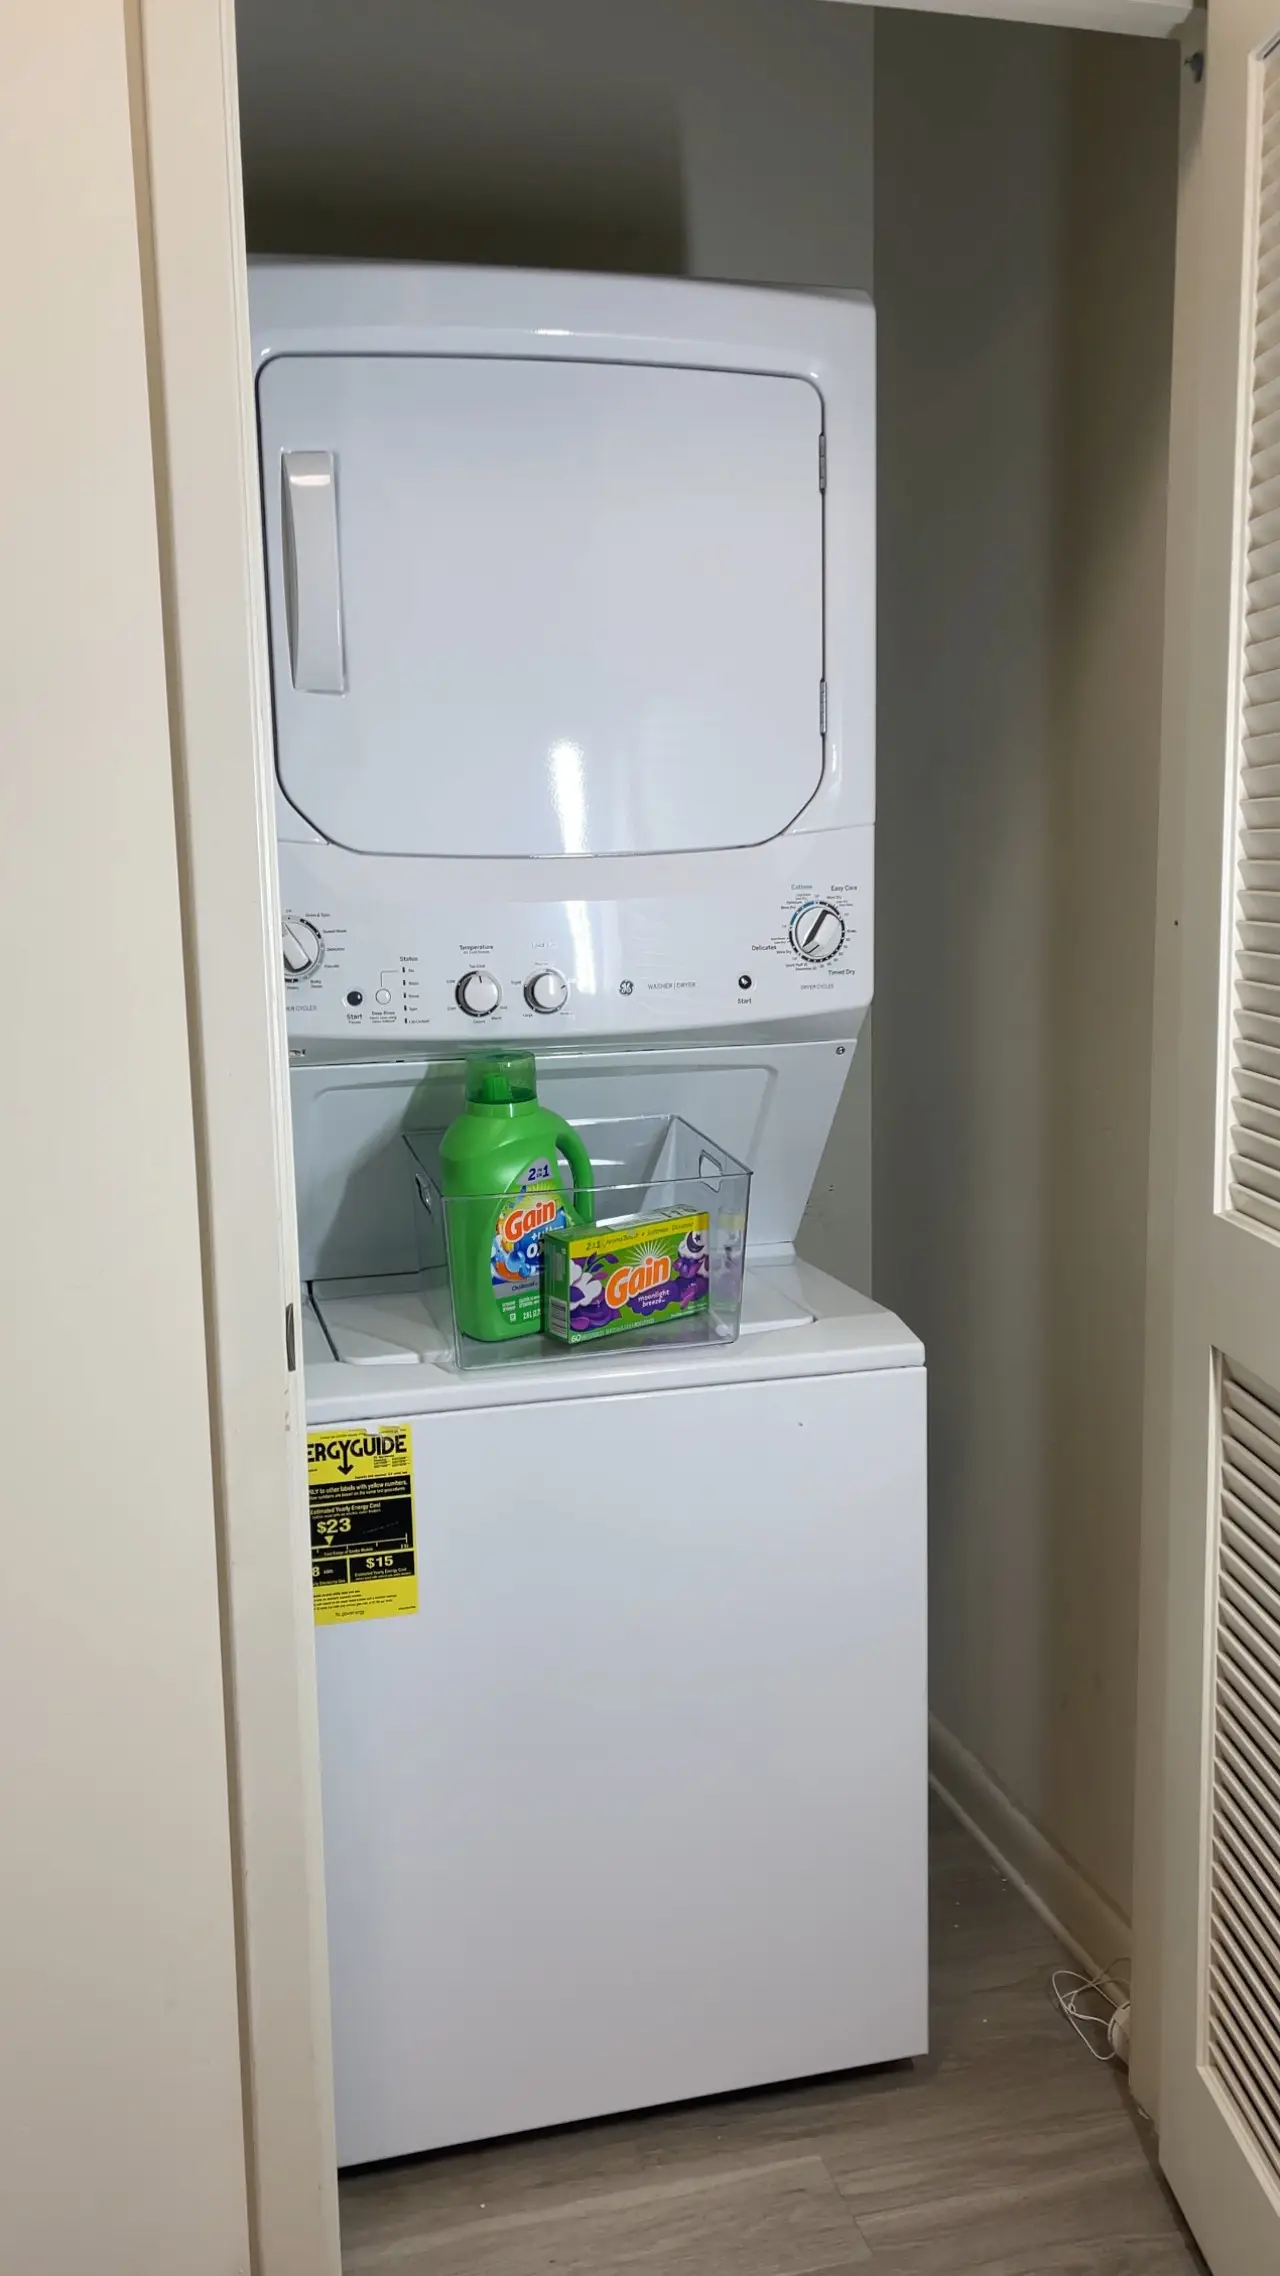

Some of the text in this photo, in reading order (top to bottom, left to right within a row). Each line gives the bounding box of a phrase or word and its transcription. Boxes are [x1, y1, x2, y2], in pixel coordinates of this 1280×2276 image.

[505, 1201, 555, 1242] Gain
[607, 1257, 669, 1307] Gain
[638, 1289, 670, 1302] moonlight
[642, 1299, 662, 1308] breeze
[571, 1334, 582, 1342] 60
[340, 1484, 356, 1492] labels
[368, 1481, 384, 1490] yellow
[385, 1480, 408, 1488] numbers.
[311, 1507, 335, 1515] Estimated
[336, 1506, 351, 1514] Yearly
[351, 1504, 369, 1513] Energy
[317, 1517, 352, 1535] $23
[366, 1555, 394, 1569] $15
